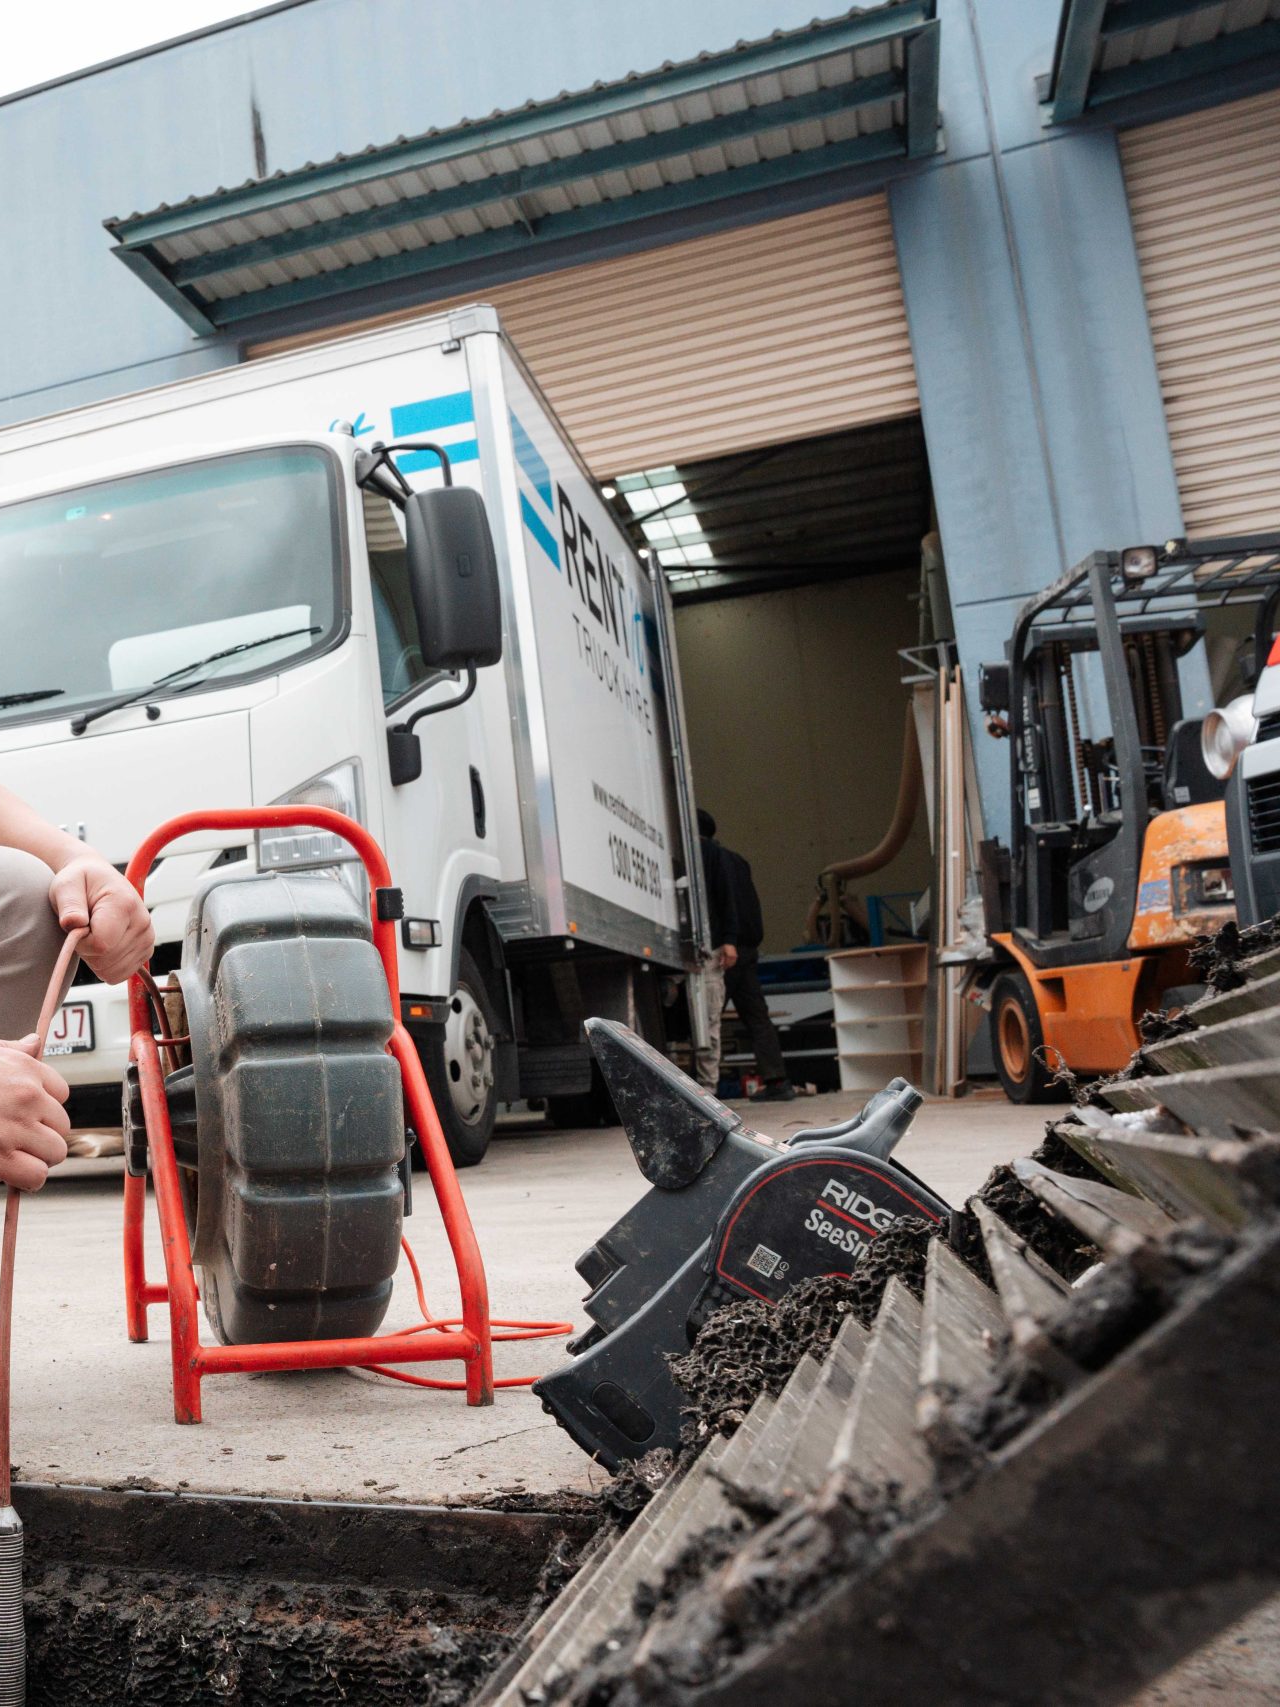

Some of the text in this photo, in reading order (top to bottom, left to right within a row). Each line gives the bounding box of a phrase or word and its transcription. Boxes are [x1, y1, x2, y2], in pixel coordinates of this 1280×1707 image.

[572, 612, 653, 736] TRUCK HIRE
[608, 831, 632, 884] 1300
